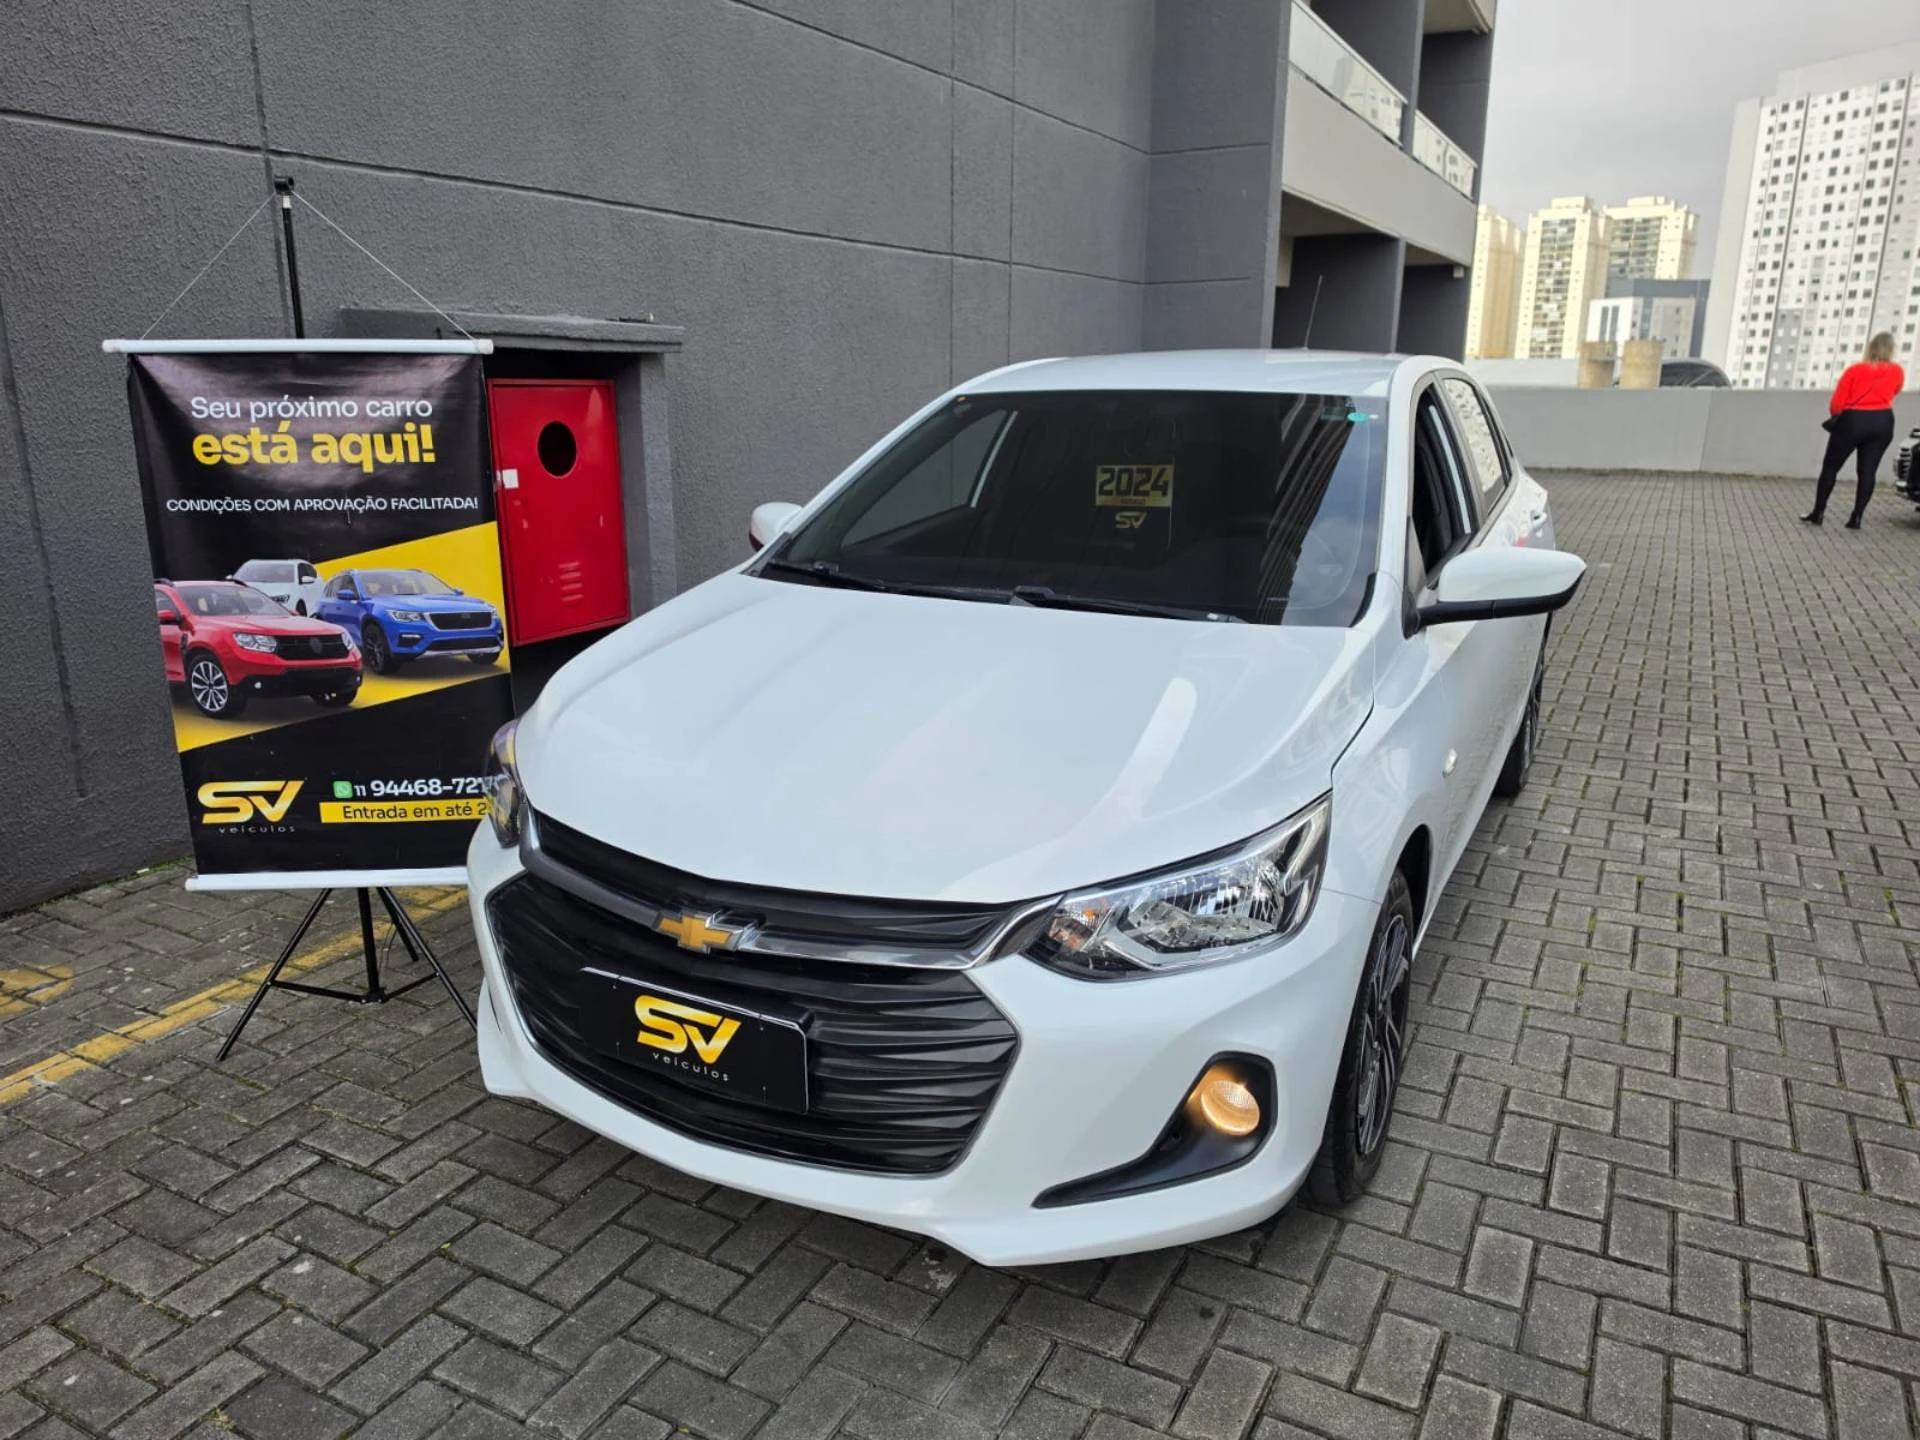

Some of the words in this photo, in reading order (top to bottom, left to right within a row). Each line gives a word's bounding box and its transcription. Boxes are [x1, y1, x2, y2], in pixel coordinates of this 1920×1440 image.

[191, 397, 240, 419] Seu
[250, 395, 358, 422] próximo
[366, 400, 433, 417] carro
[193, 420, 298, 465] está
[311, 422, 436, 473] aqui!
[1098, 467, 1169, 497] 2024
[166, 496, 251, 514] CONDIÇÕES
[254, 499, 290, 512] COM
[294, 496, 387, 513] APROVAÇÃO
[391, 498, 479, 510] FACILITADA!
[1115, 511, 1147, 528] SV
[198, 780, 304, 823] SV
[343, 802, 407, 819] Entrada
[413, 805, 439, 816] em
[445, 802, 472, 816] até
[219, 824, 295, 833] veiculos
[634, 995, 742, 1064] SV
[652, 1051, 729, 1082] veiculos
